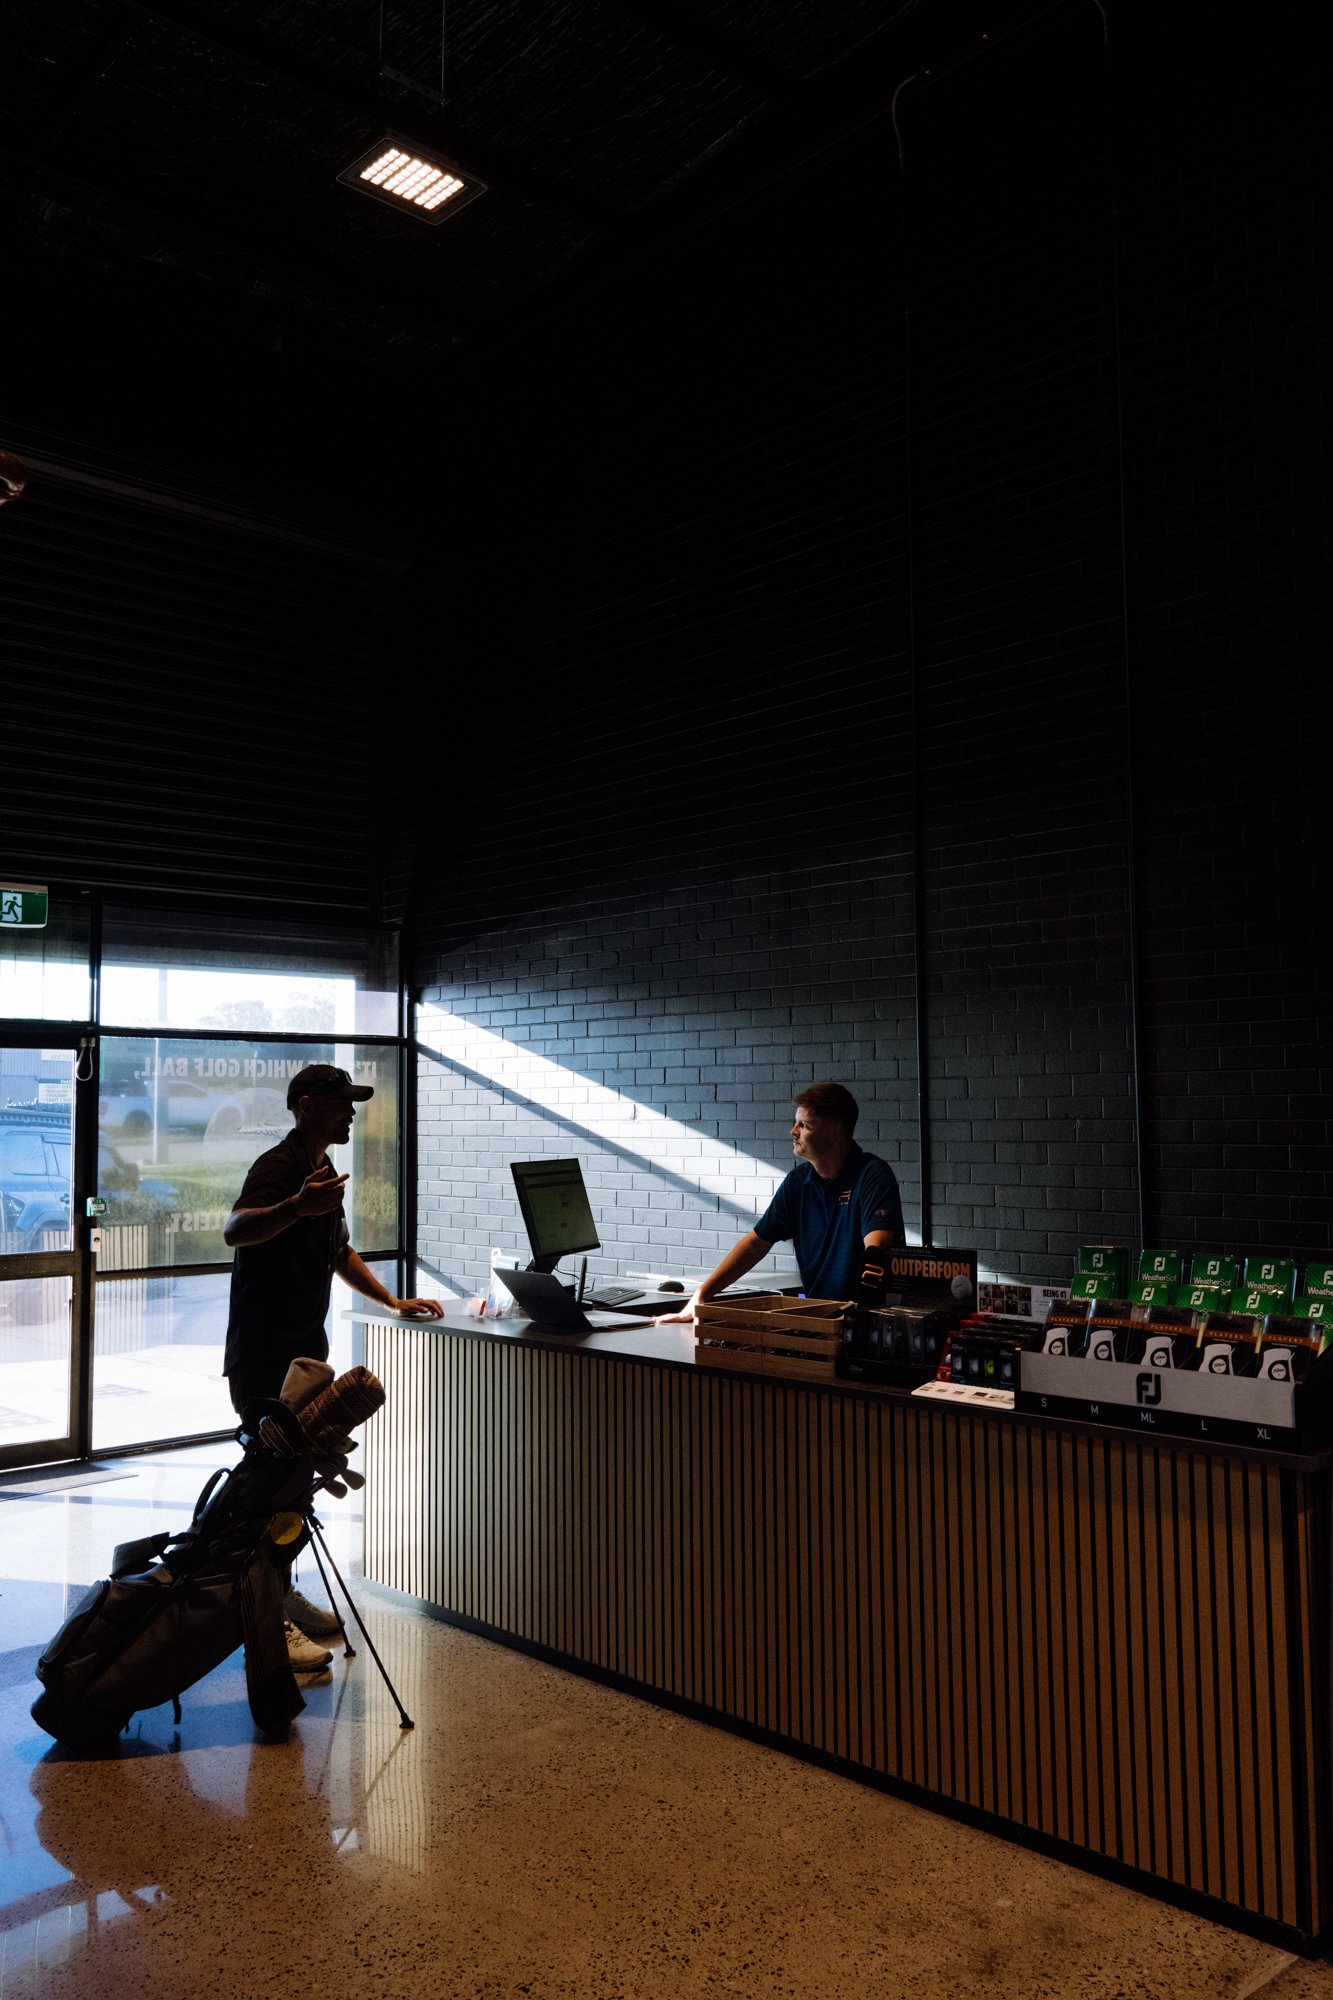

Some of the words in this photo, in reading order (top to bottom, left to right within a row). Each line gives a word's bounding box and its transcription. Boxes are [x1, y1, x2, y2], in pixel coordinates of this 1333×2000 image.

[891, 1257, 971, 1281] OUTPERFORM
[1043, 1289, 1059, 1298] BEING
[1136, 1373, 1162, 1405] FJ
[1040, 1397, 1048, 1408] S
[1090, 1404, 1099, 1416] M
[1140, 1410, 1156, 1424] ML
[1201, 1419, 1209, 1431] L
[1256, 1427, 1271, 1440] XL
